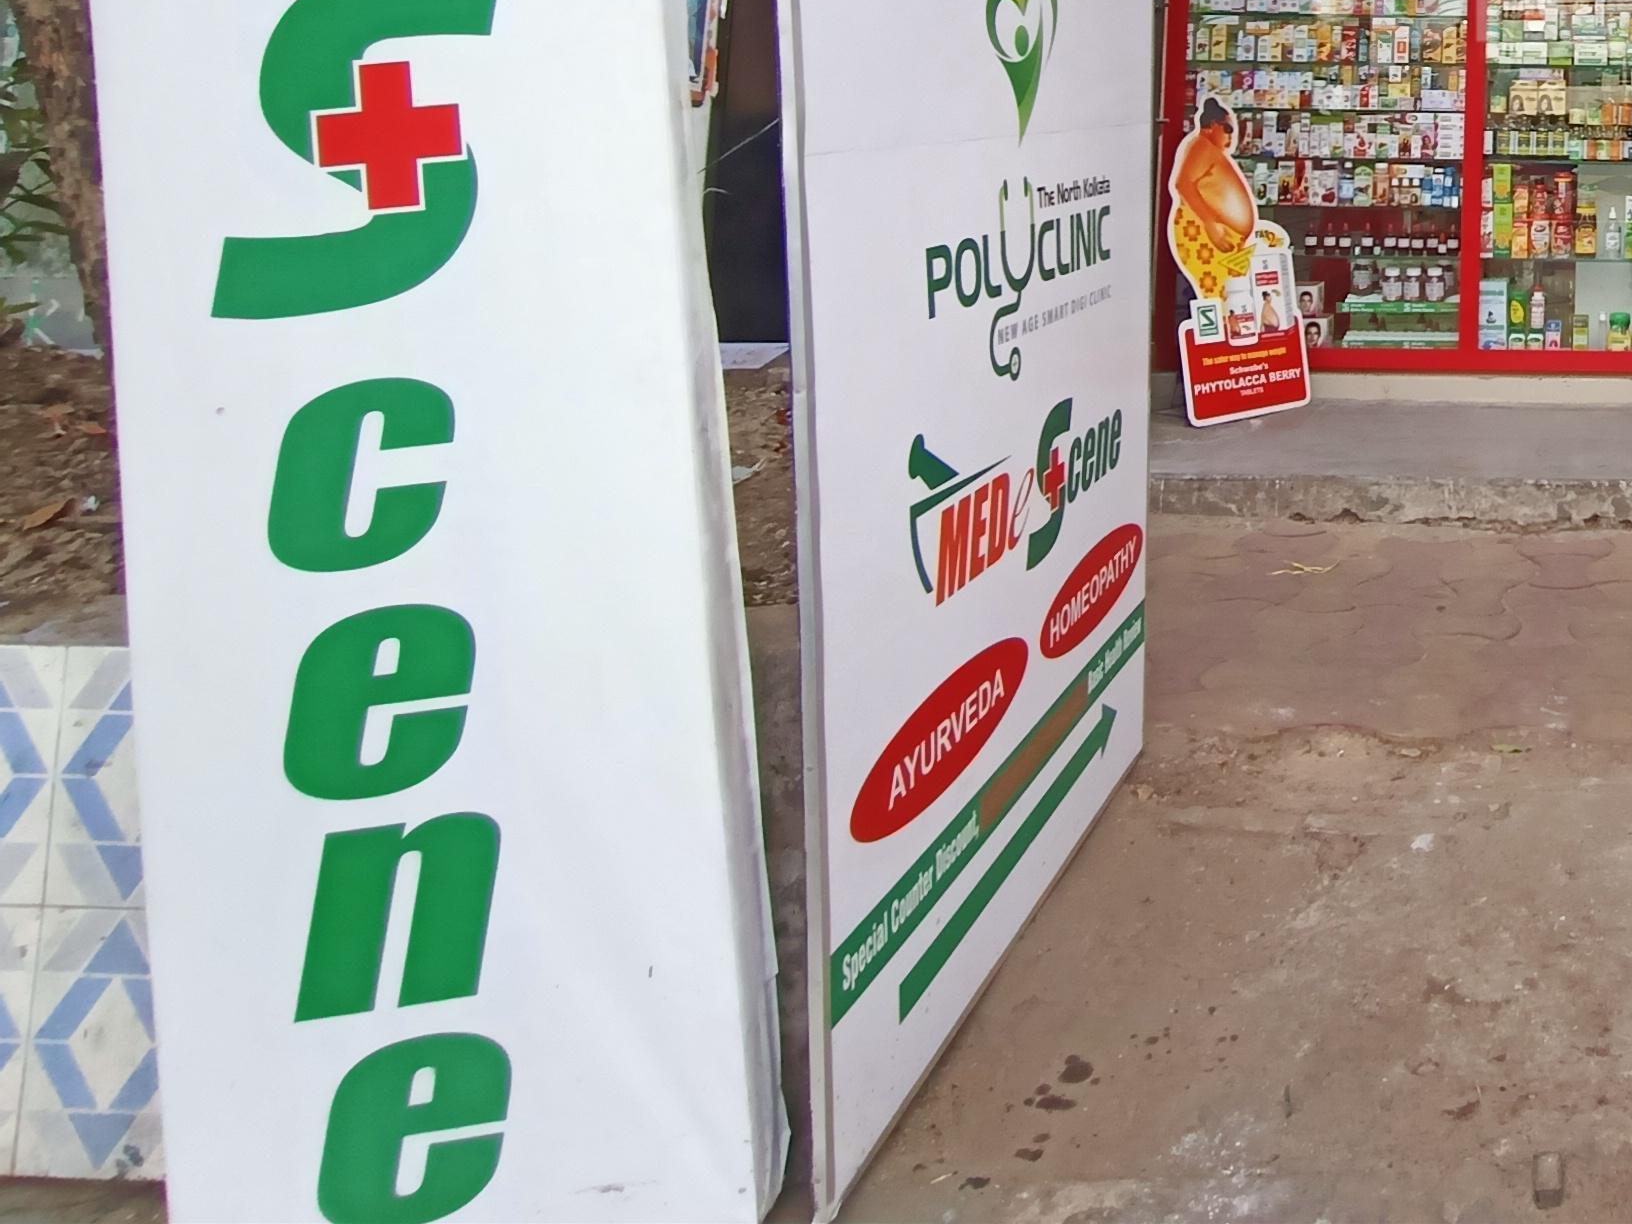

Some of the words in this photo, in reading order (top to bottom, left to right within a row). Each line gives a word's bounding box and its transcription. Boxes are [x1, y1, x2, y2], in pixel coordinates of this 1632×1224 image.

[1037, 186, 1055, 208] The
[1057, 180, 1082, 204] North
[1083, 175, 1111, 199] Kolkata
[926, 201, 1110, 320] POLYCLINIC
[997, 322, 1020, 345] NEW
[1021, 314, 1039, 337] AGE
[1042, 300, 1068, 327] SMART
[1071, 295, 1087, 315] DIGI
[1088, 284, 1112, 307] CLINIC
[1193, 373, 1267, 396] PHYTOLACCA
[1269, 367, 1301, 382] BERRY
[1049, 536, 1137, 648] HOMEOPATHY
[888, 668, 1004, 811] AYURVEDA
[842, 911, 889, 991] Special
[891, 865, 934, 934] Counter
